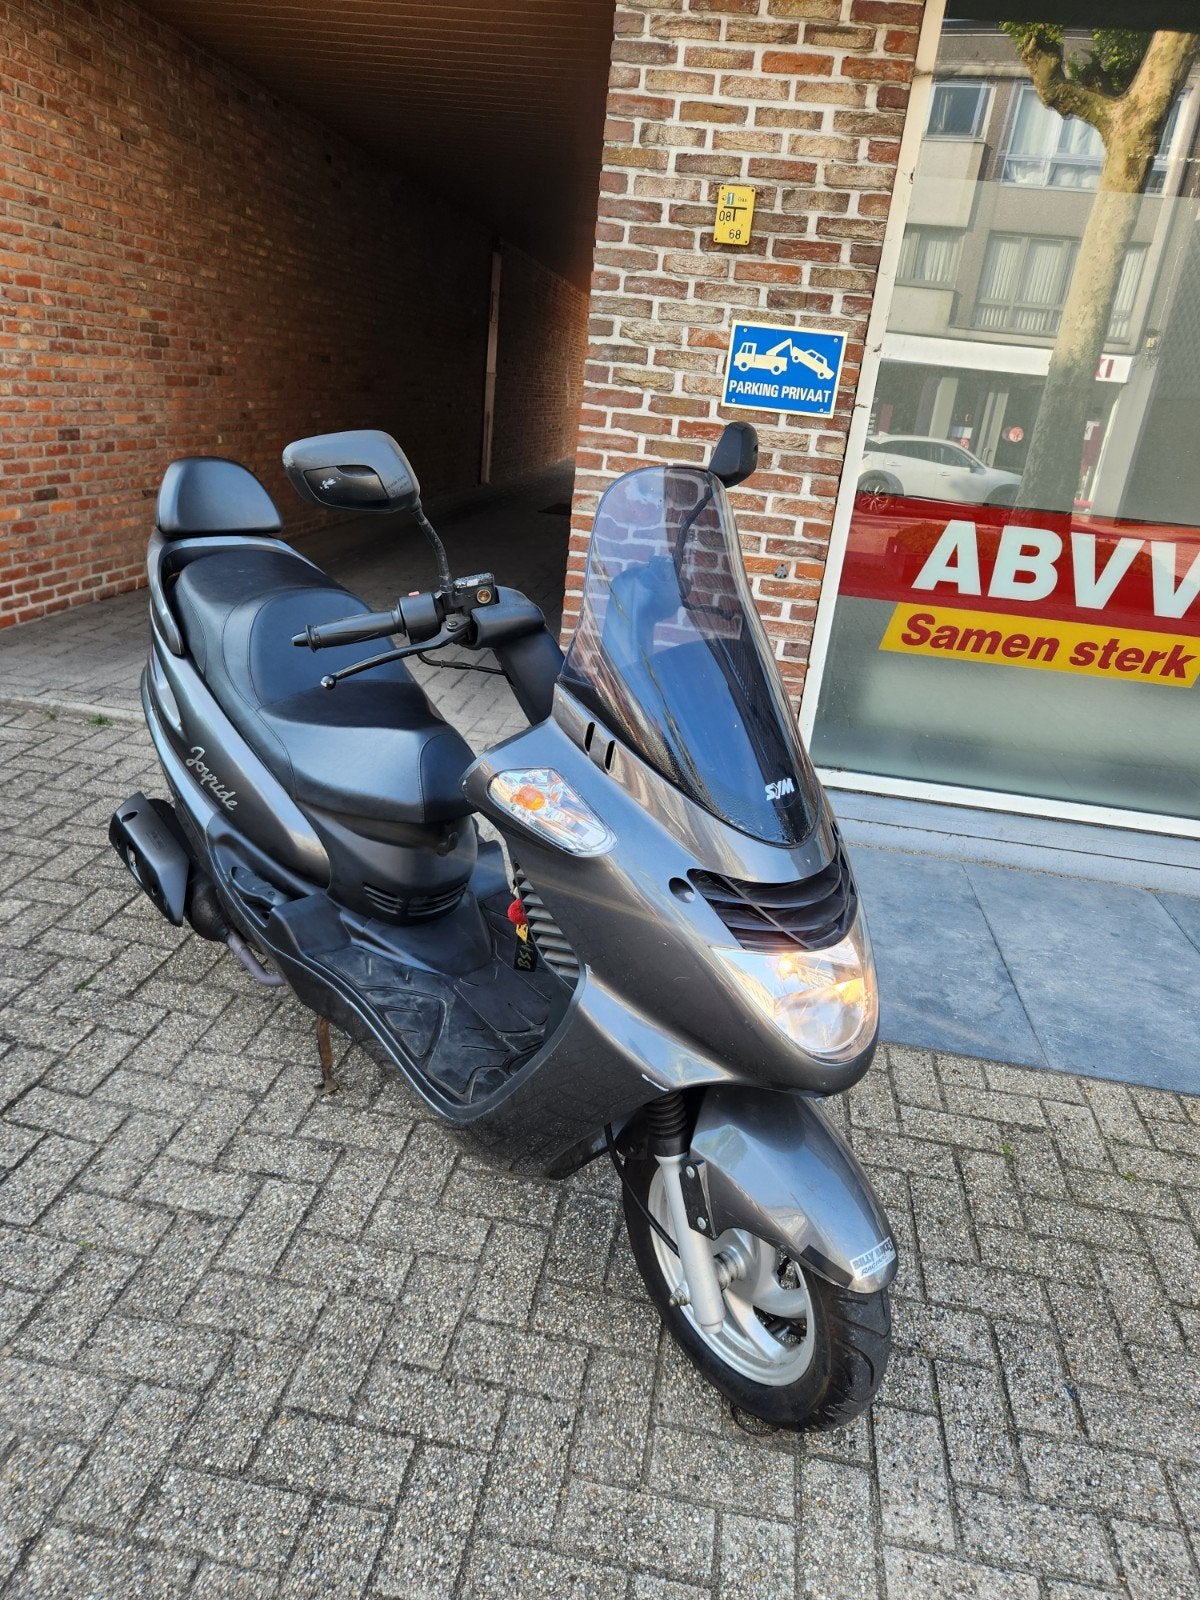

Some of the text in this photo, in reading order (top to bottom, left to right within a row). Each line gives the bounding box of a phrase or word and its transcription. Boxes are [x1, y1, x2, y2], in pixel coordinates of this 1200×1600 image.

[719, 210, 732, 222] 08
[729, 229, 742, 240] 68
[729, 380, 832, 403] PARKING PRIVAAT
[911, 519, 1200, 619] ABVV
[900, 612, 1198, 679] Samen sterk
[185, 746, 238, 811] Joyride
[764, 777, 795, 801] SYM
